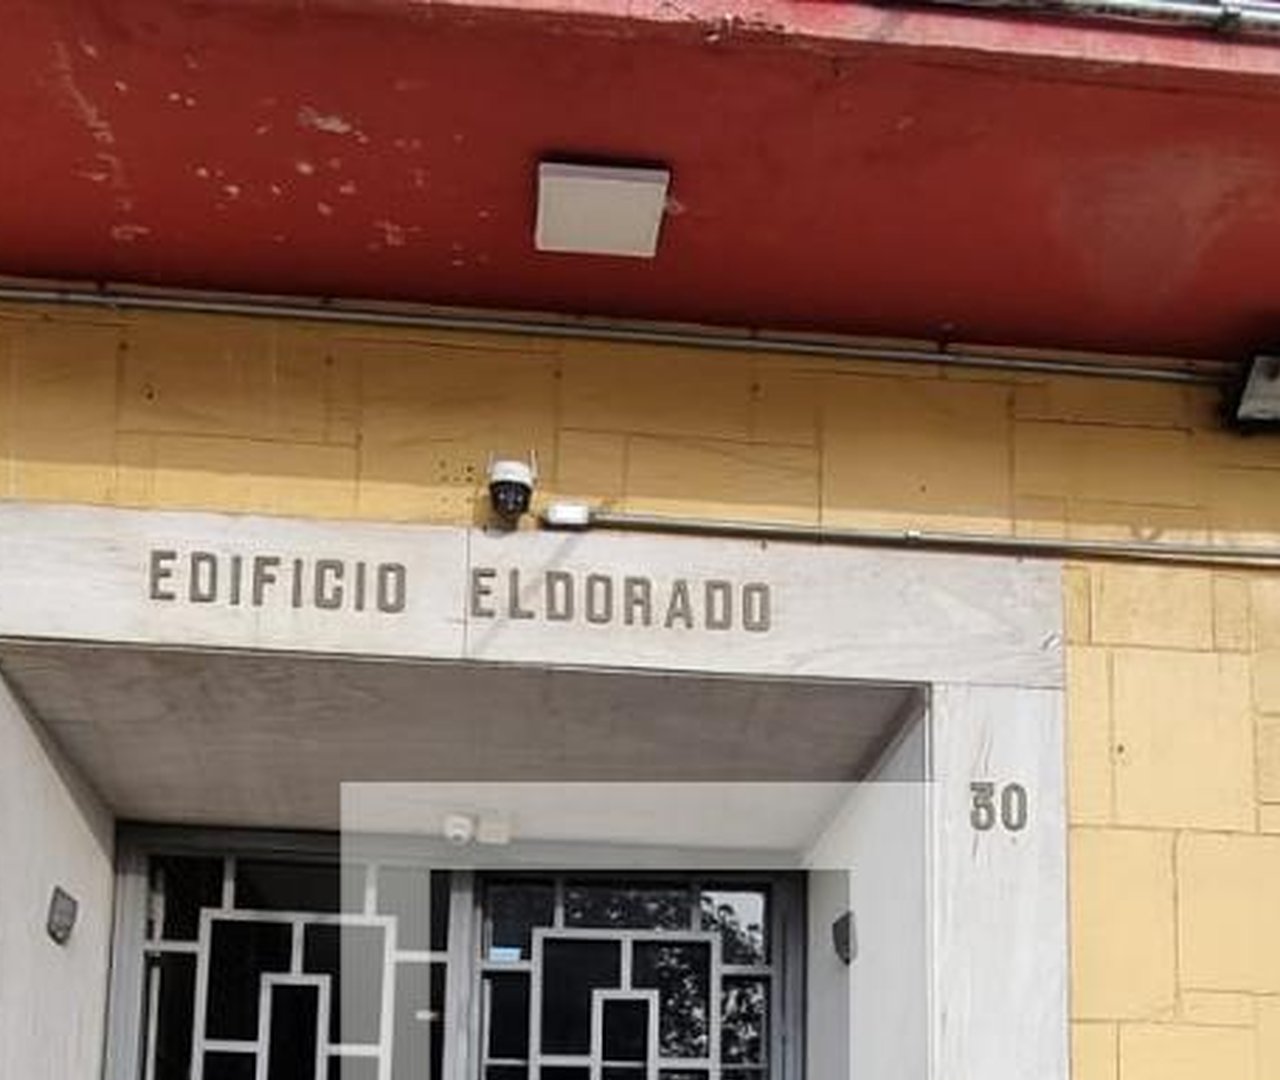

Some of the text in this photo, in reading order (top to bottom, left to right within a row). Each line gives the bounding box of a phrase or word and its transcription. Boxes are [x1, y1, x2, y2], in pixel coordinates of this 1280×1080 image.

[148, 549, 772, 633] EDIFICIO ELDORADO
[969, 781, 1028, 832] 30
